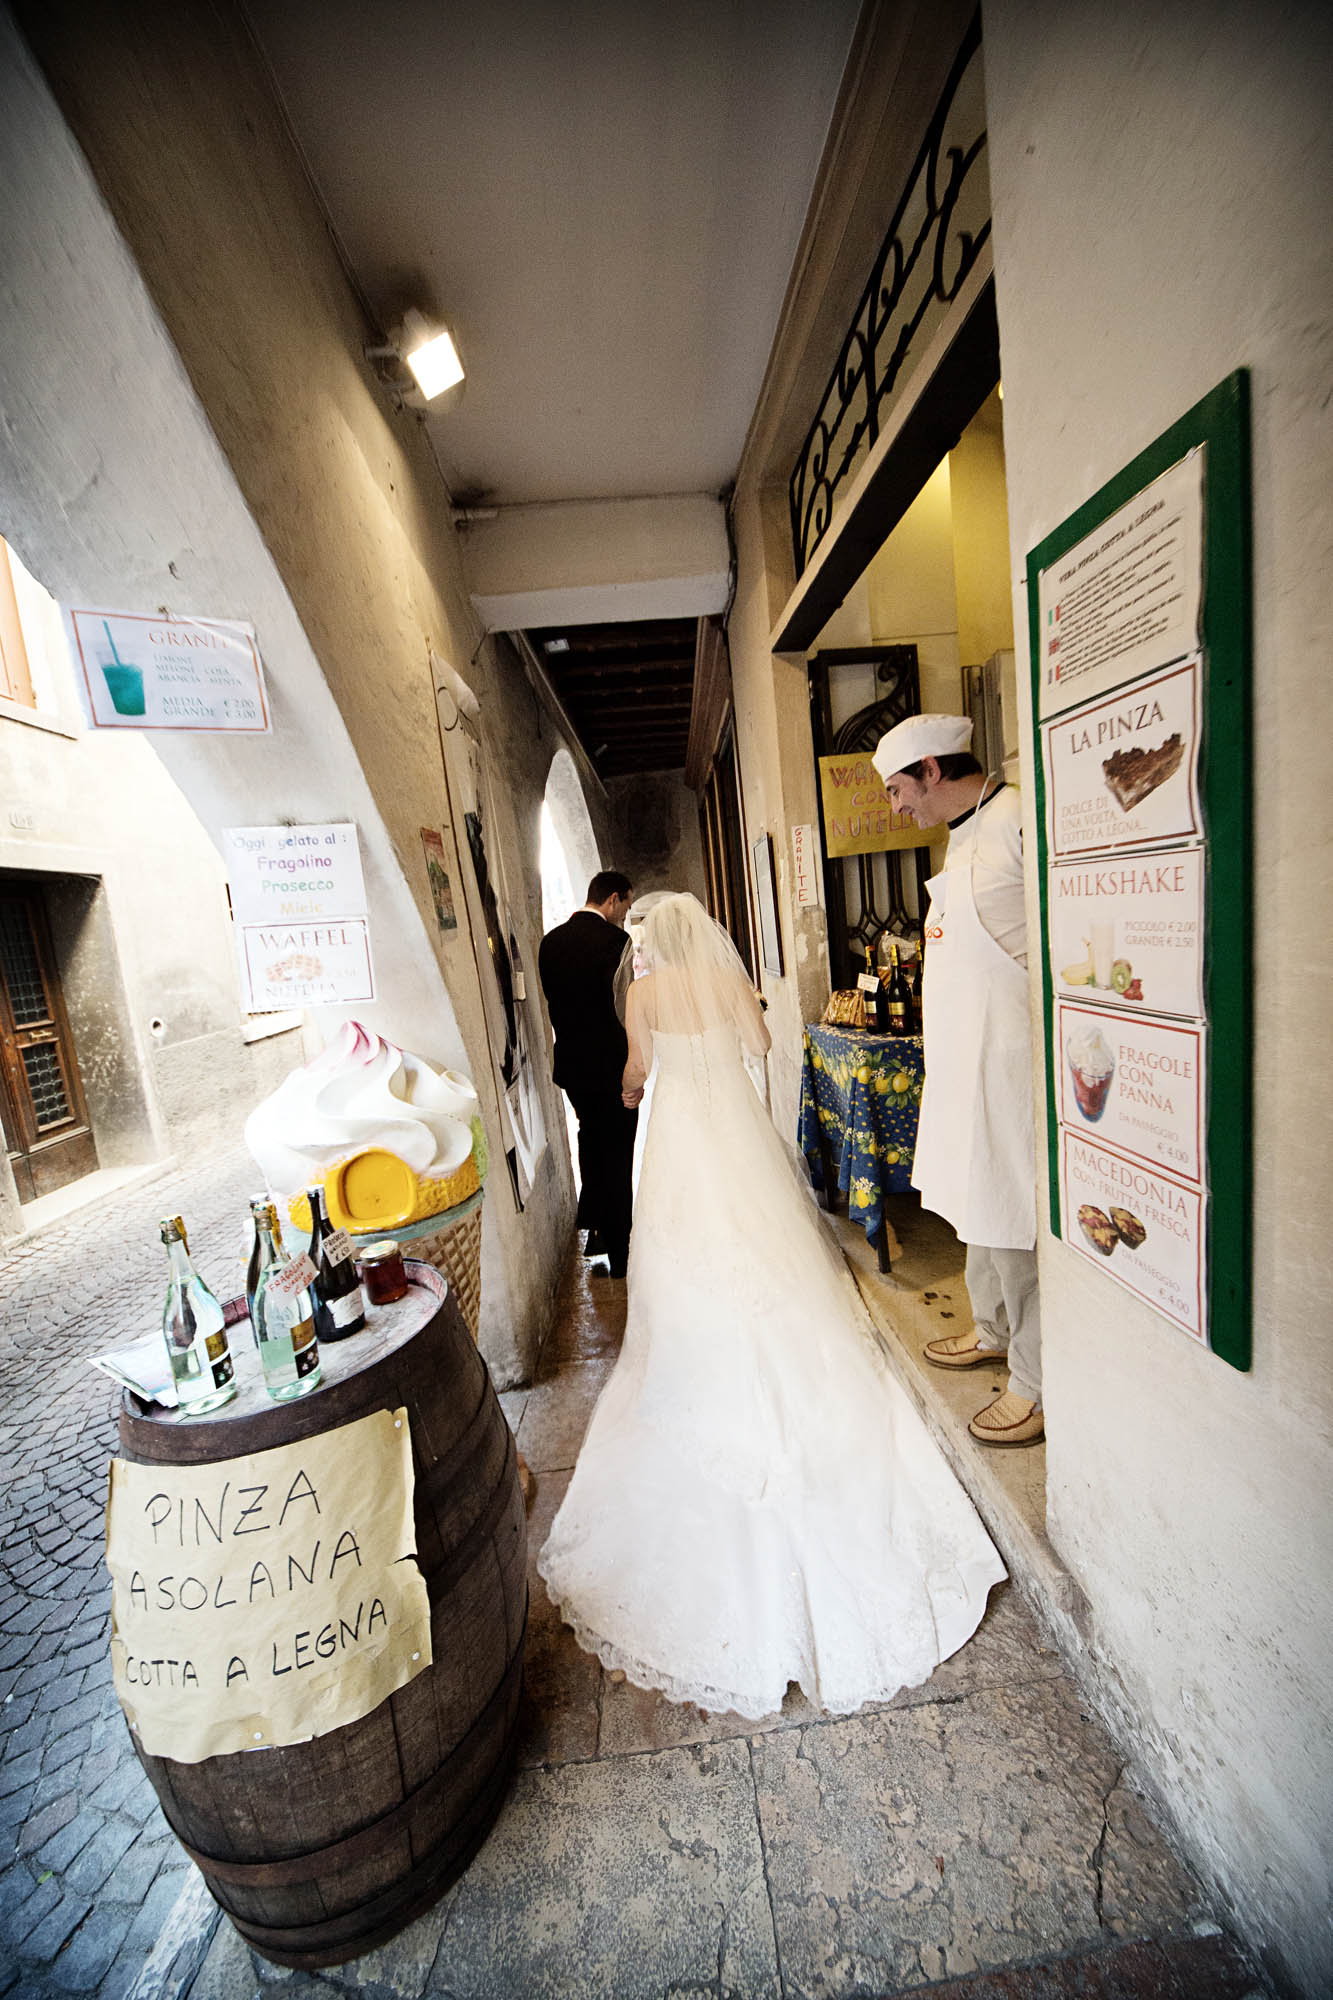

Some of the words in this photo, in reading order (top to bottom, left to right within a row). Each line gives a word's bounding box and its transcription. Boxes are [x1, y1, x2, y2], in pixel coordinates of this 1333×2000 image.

[162, 696, 203, 706] MEDIA
[163, 705, 217, 718] GRANDE
[1070, 728, 1093, 755] LA
[1097, 699, 1165, 744] PINZA
[1061, 800, 1094, 818] DOLCE
[233, 835, 265, 852] Oggi
[278, 834, 320, 850] gelato
[323, 832, 336, 845] al
[256, 854, 333, 873] Fragolino
[794, 826, 809, 902] GRANITE
[261, 879, 335, 893] Prosecco
[1058, 865, 1185, 898] MILKSHAKE
[279, 899, 325, 915] Miele
[1124, 921, 1166, 933] PICCOLO
[258, 928, 353, 951] WAFFEL
[1124, 935, 1165, 948] GRANDE
[1119, 1045, 1193, 1079] FRAGOLE
[1118, 1064, 1155, 1087] CON
[1119, 1083, 1175, 1114] PANNA
[1073, 1145, 1188, 1218] MACEDONIA
[1072, 1166, 1097, 1187] CON
[1099, 1180, 1142, 1215] FRUTTA
[1145, 1202, 1192, 1243] FRESCA
[143, 1469, 322, 1546] PINZA
[130, 1530, 363, 1612] ASOLANA
[125, 1655, 200, 1688] COTTA
[226, 1655, 249, 1689] A
[271, 1597, 389, 1676] LEGNA
